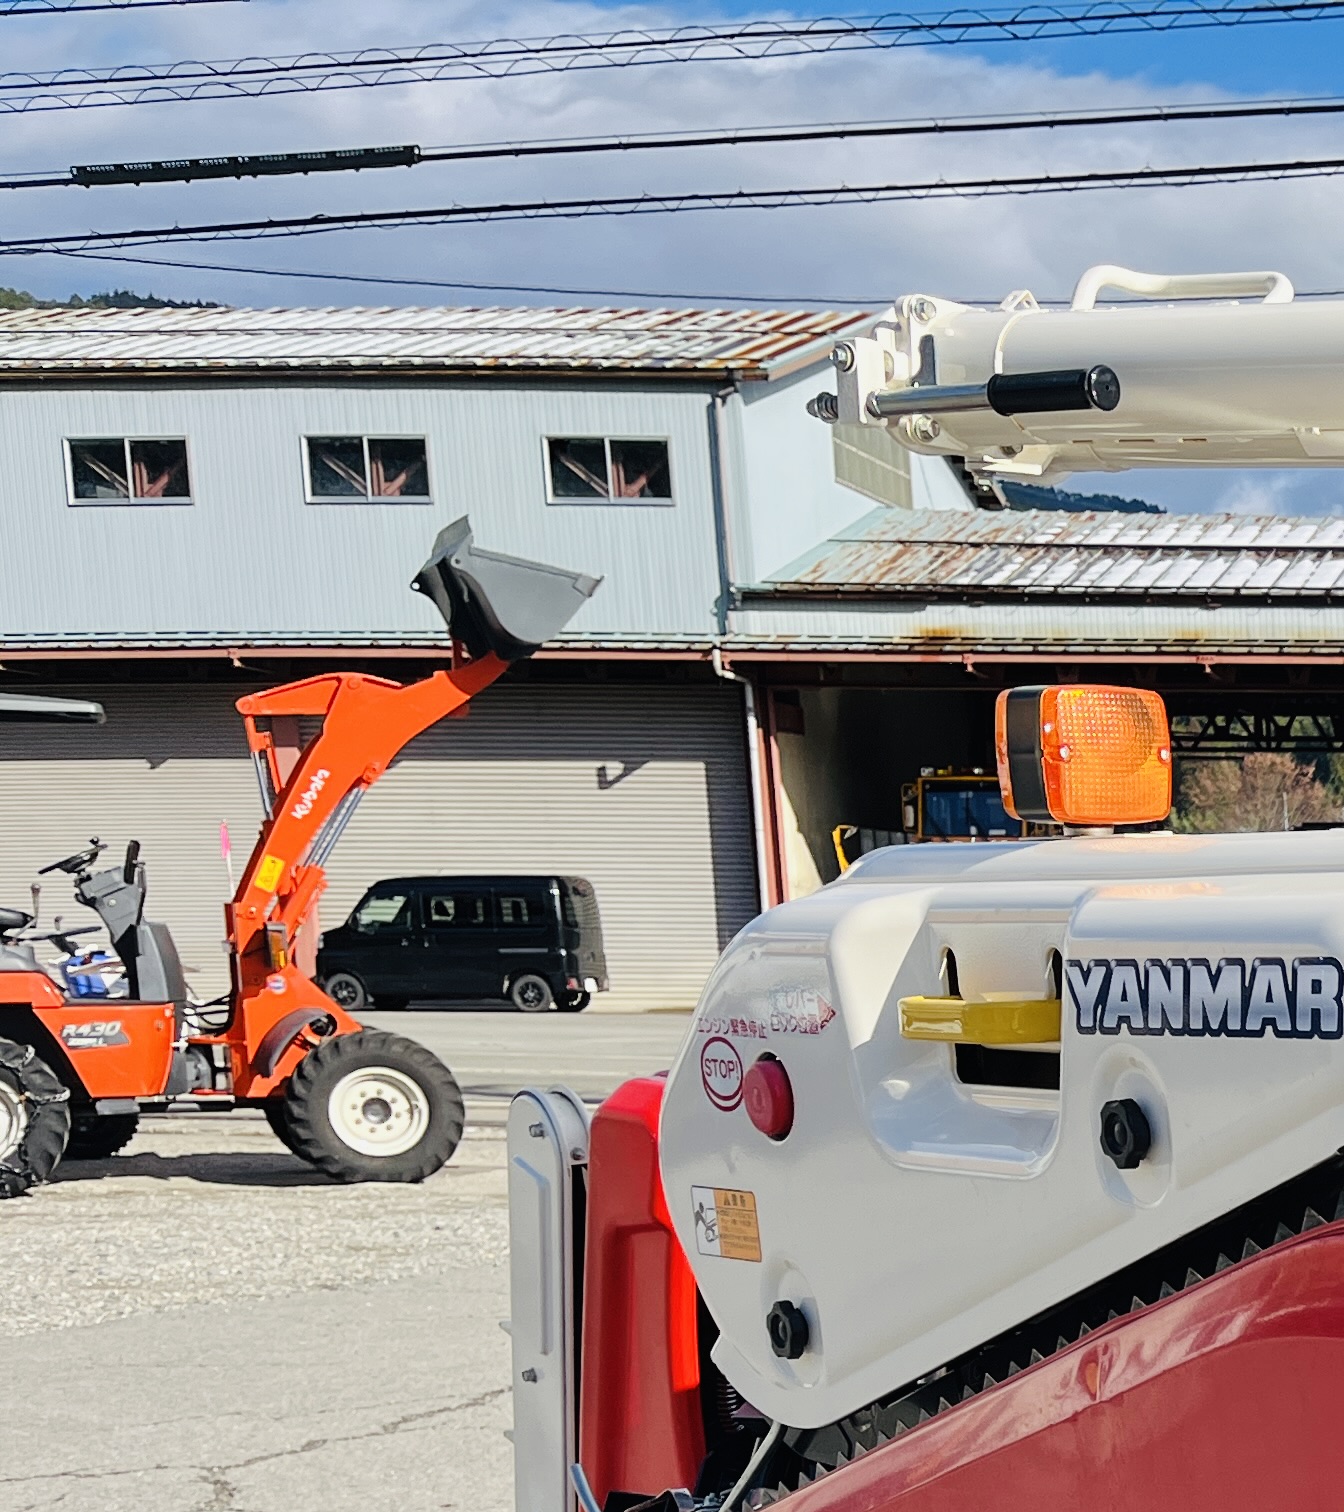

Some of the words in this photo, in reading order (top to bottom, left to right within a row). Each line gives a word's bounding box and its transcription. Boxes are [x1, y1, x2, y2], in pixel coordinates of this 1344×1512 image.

[291, 768, 330, 819] Kubota
[1066, 956, 1344, 1040] YANMAR
[61, 1021, 122, 1038] R430
[698, 1017, 768, 1040] エンジン緊急停止
[704, 1057, 740, 1081] STOP!
